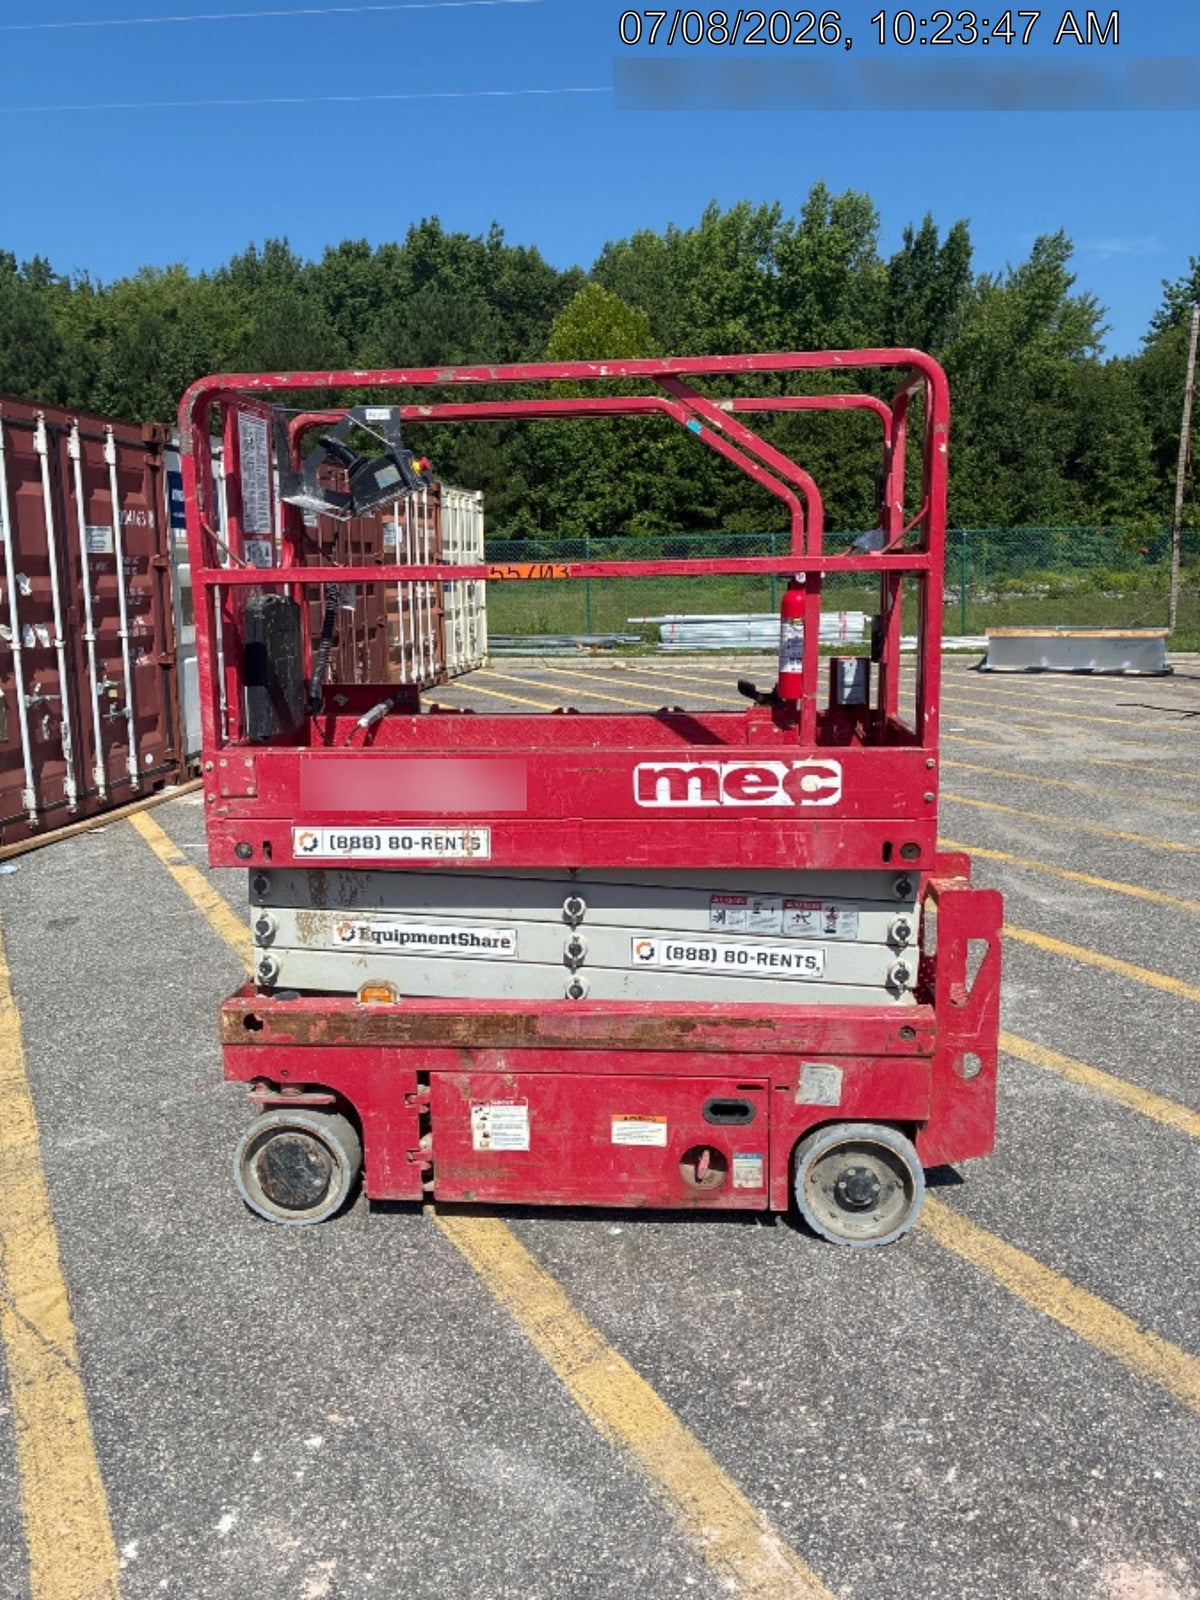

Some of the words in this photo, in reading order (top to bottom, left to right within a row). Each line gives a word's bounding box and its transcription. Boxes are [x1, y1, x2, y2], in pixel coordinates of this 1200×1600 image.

[637, 765, 840, 804] mec
[330, 835, 381, 850] (888)
[388, 835, 482, 851] 80-RENTS
[357, 925, 512, 950] EquipmentShare
[666, 945, 717, 963] (888)
[724, 950, 817, 969] 80-RENTS
